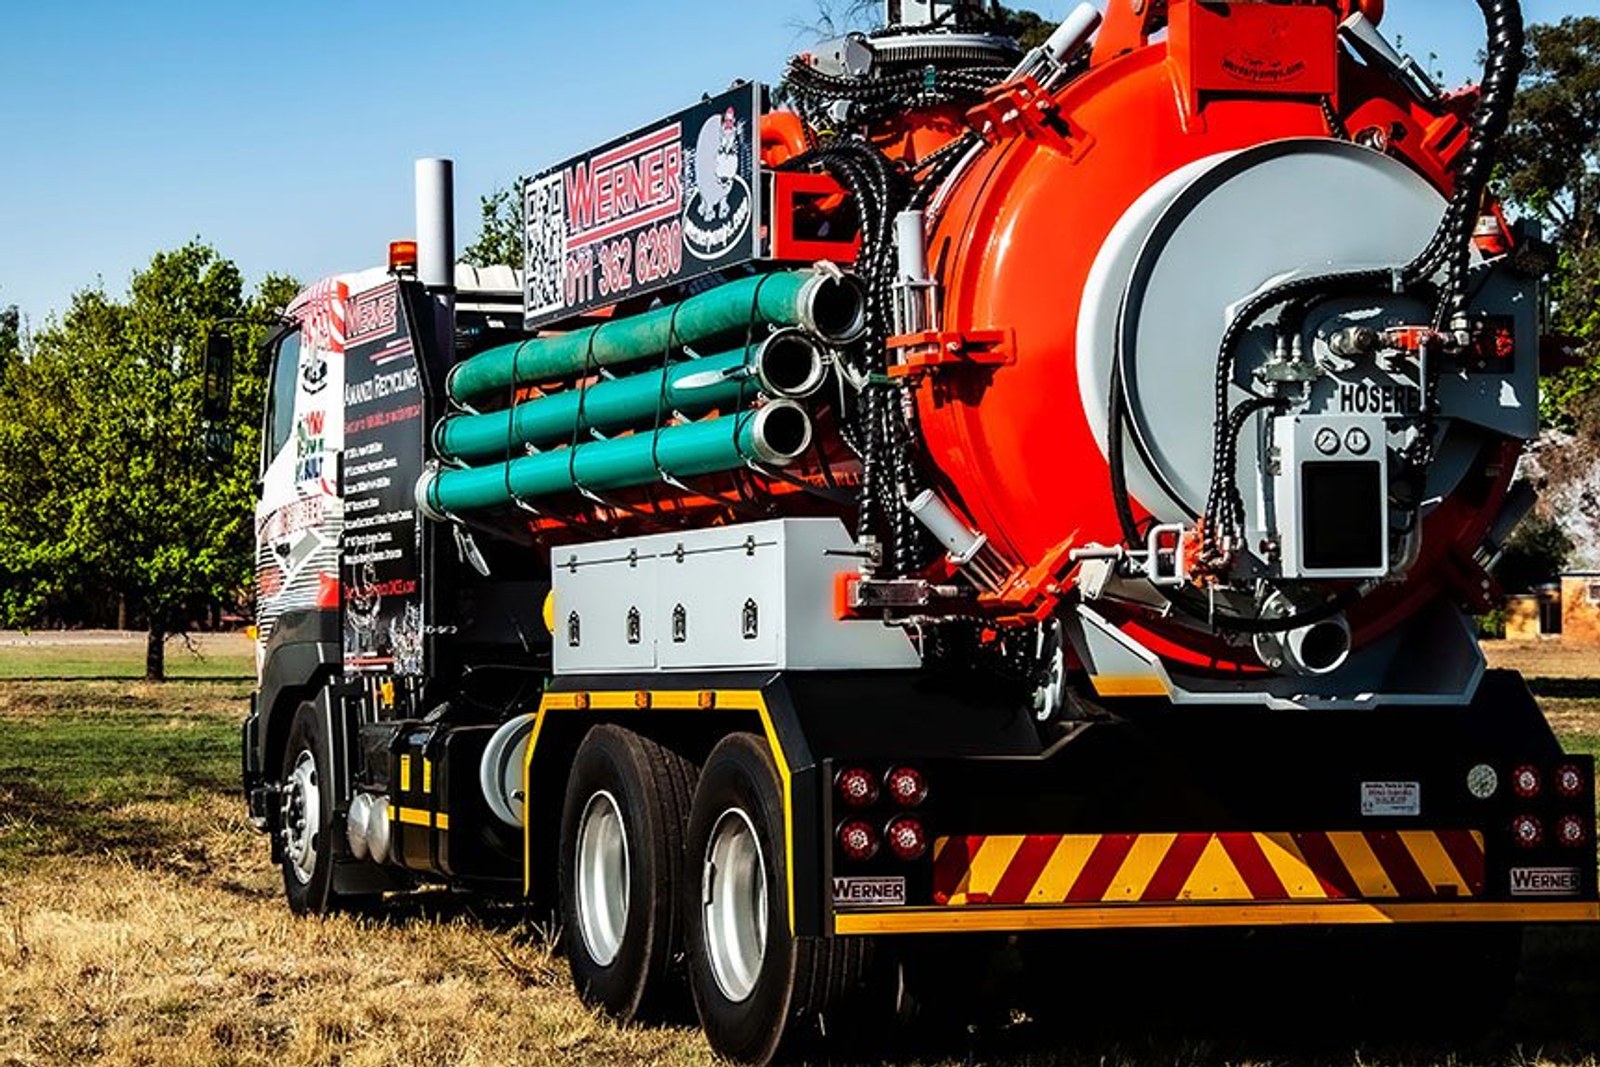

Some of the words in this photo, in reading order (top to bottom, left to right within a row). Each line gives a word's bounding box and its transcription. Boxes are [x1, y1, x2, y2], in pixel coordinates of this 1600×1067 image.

[564, 143, 682, 231] WERNER
[566, 255, 594, 307] 011
[598, 237, 632, 296] 362
[635, 219, 682, 284] 6280
[1341, 384, 1421, 412] HOSERE
[832, 880, 904, 901] WERNER
[1512, 870, 1578, 888] WERNER
